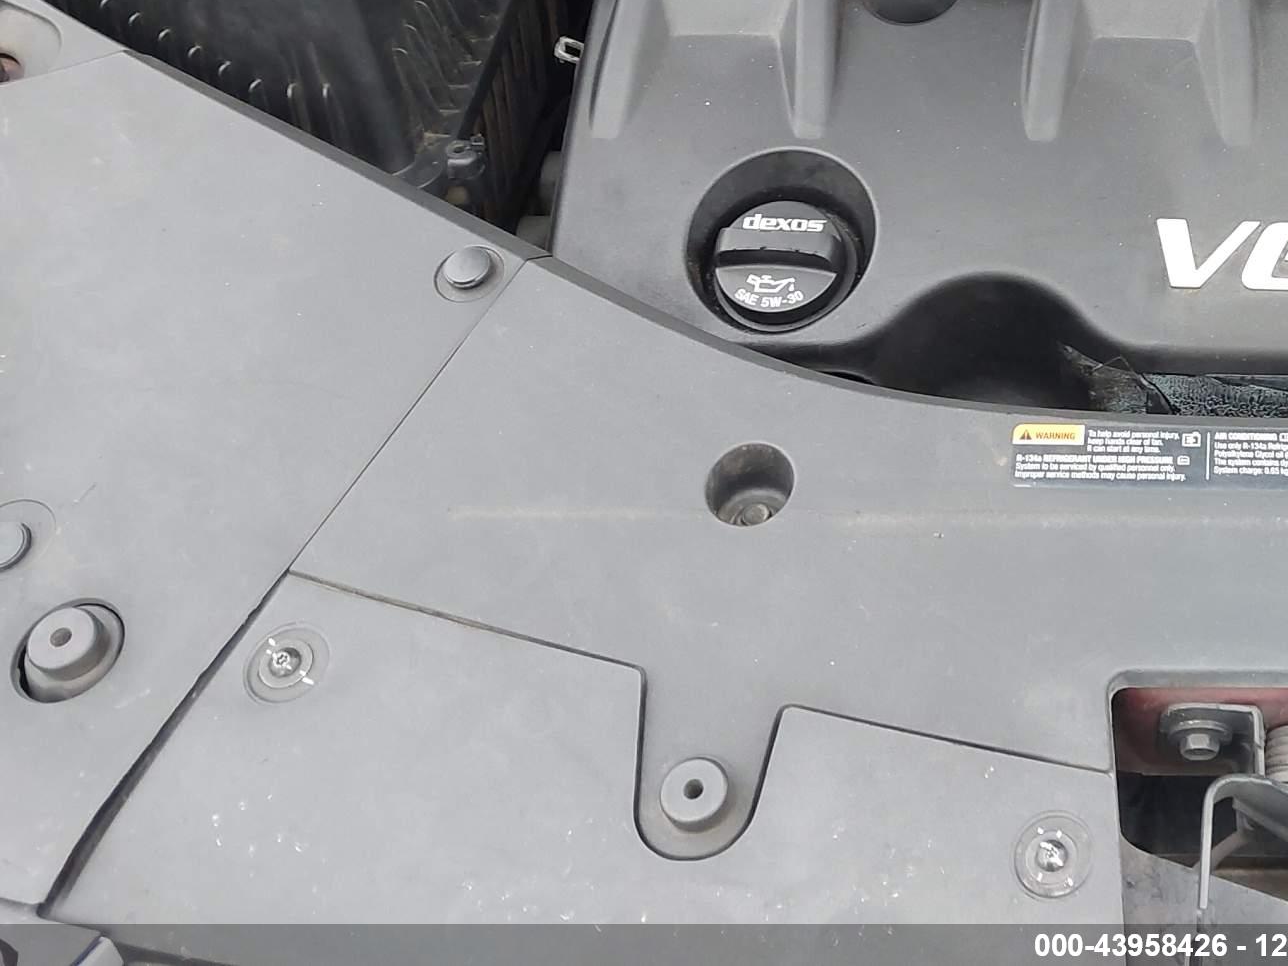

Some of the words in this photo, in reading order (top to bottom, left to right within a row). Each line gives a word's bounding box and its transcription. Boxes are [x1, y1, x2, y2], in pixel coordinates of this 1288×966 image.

[743, 214, 828, 233] dexos
[734, 288, 760, 306] SAE
[760, 290, 804, 308] 5W-30
[1035, 431, 1076, 441] WARNING
